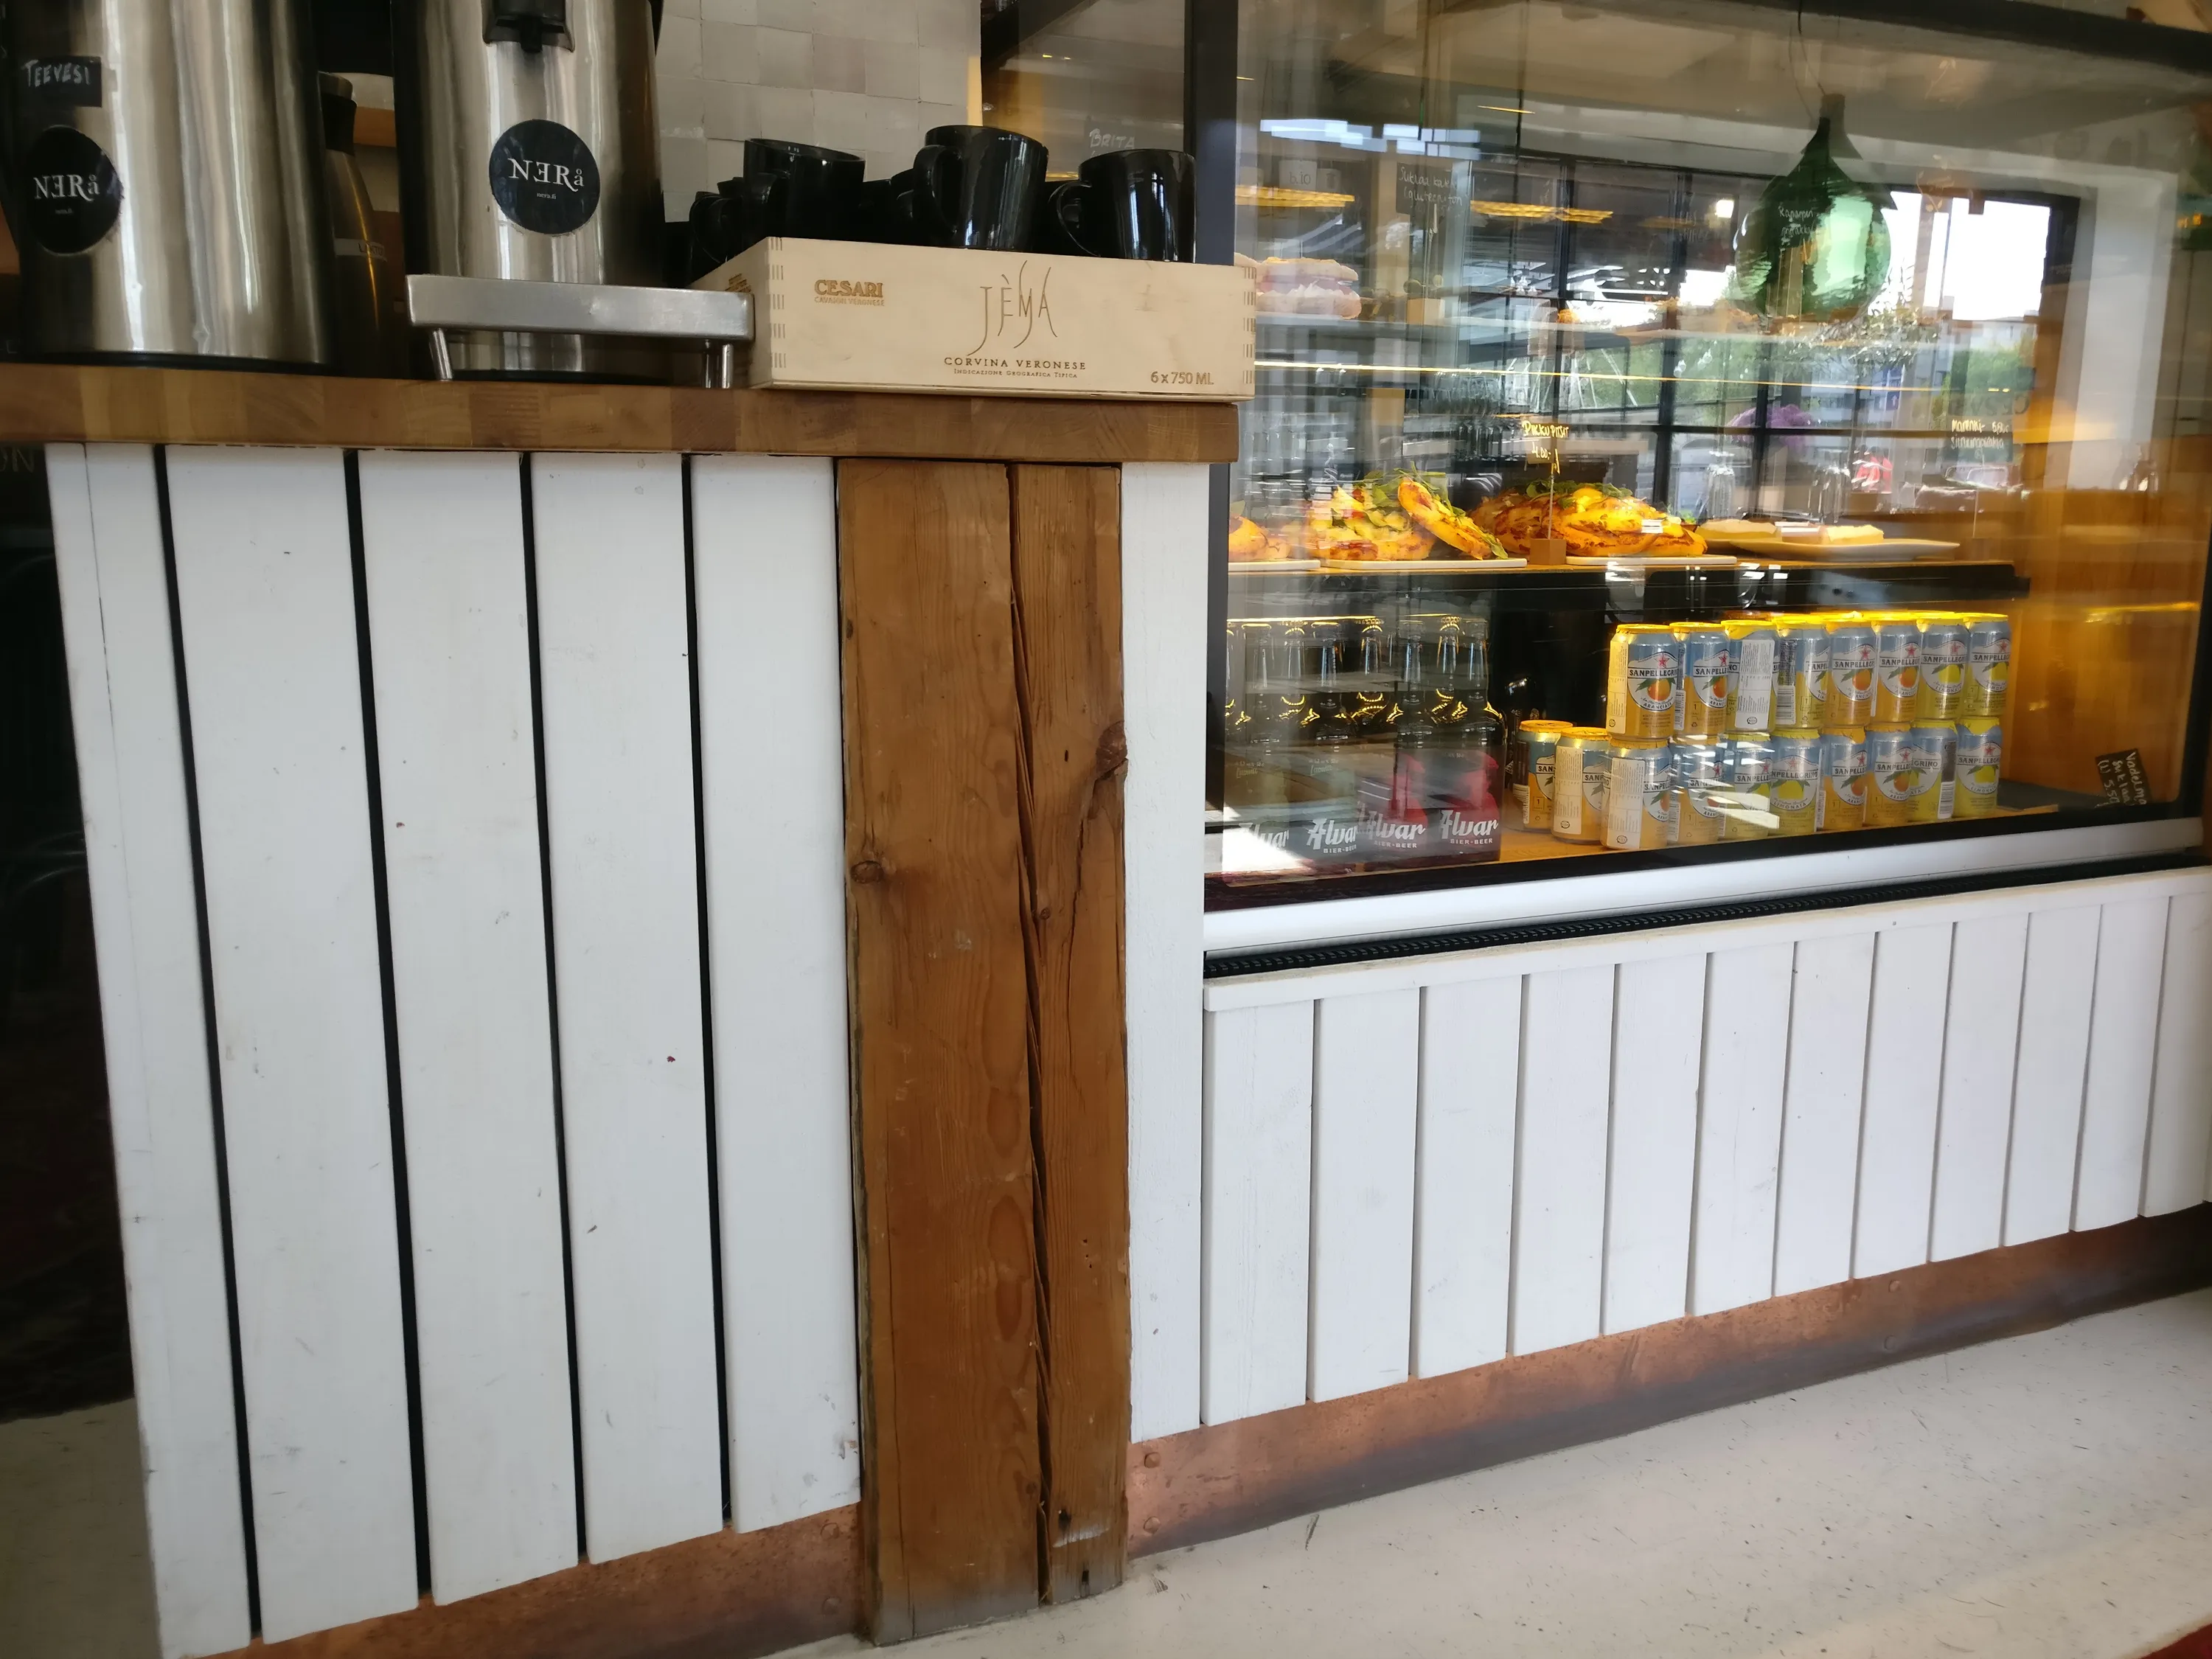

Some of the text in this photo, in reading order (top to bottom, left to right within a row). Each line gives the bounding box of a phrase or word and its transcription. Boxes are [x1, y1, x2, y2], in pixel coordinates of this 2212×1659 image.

[21, 59, 91, 87] TEEVESI
[1089, 128, 1135, 149] BRITA
[814, 279, 883, 298] CESARI
[848, 298, 885, 307] VERONESE
[944, 358, 1086, 370] CORVINA VERONESE
[1196, 372, 1214, 385] ML
[1521, 420, 1569, 438] PIKKU PITSAT
[2126, 752, 2147, 804] Vadelma
[1367, 811, 1426, 840] Alvar
[1441, 810, 1499, 838] Alvar
